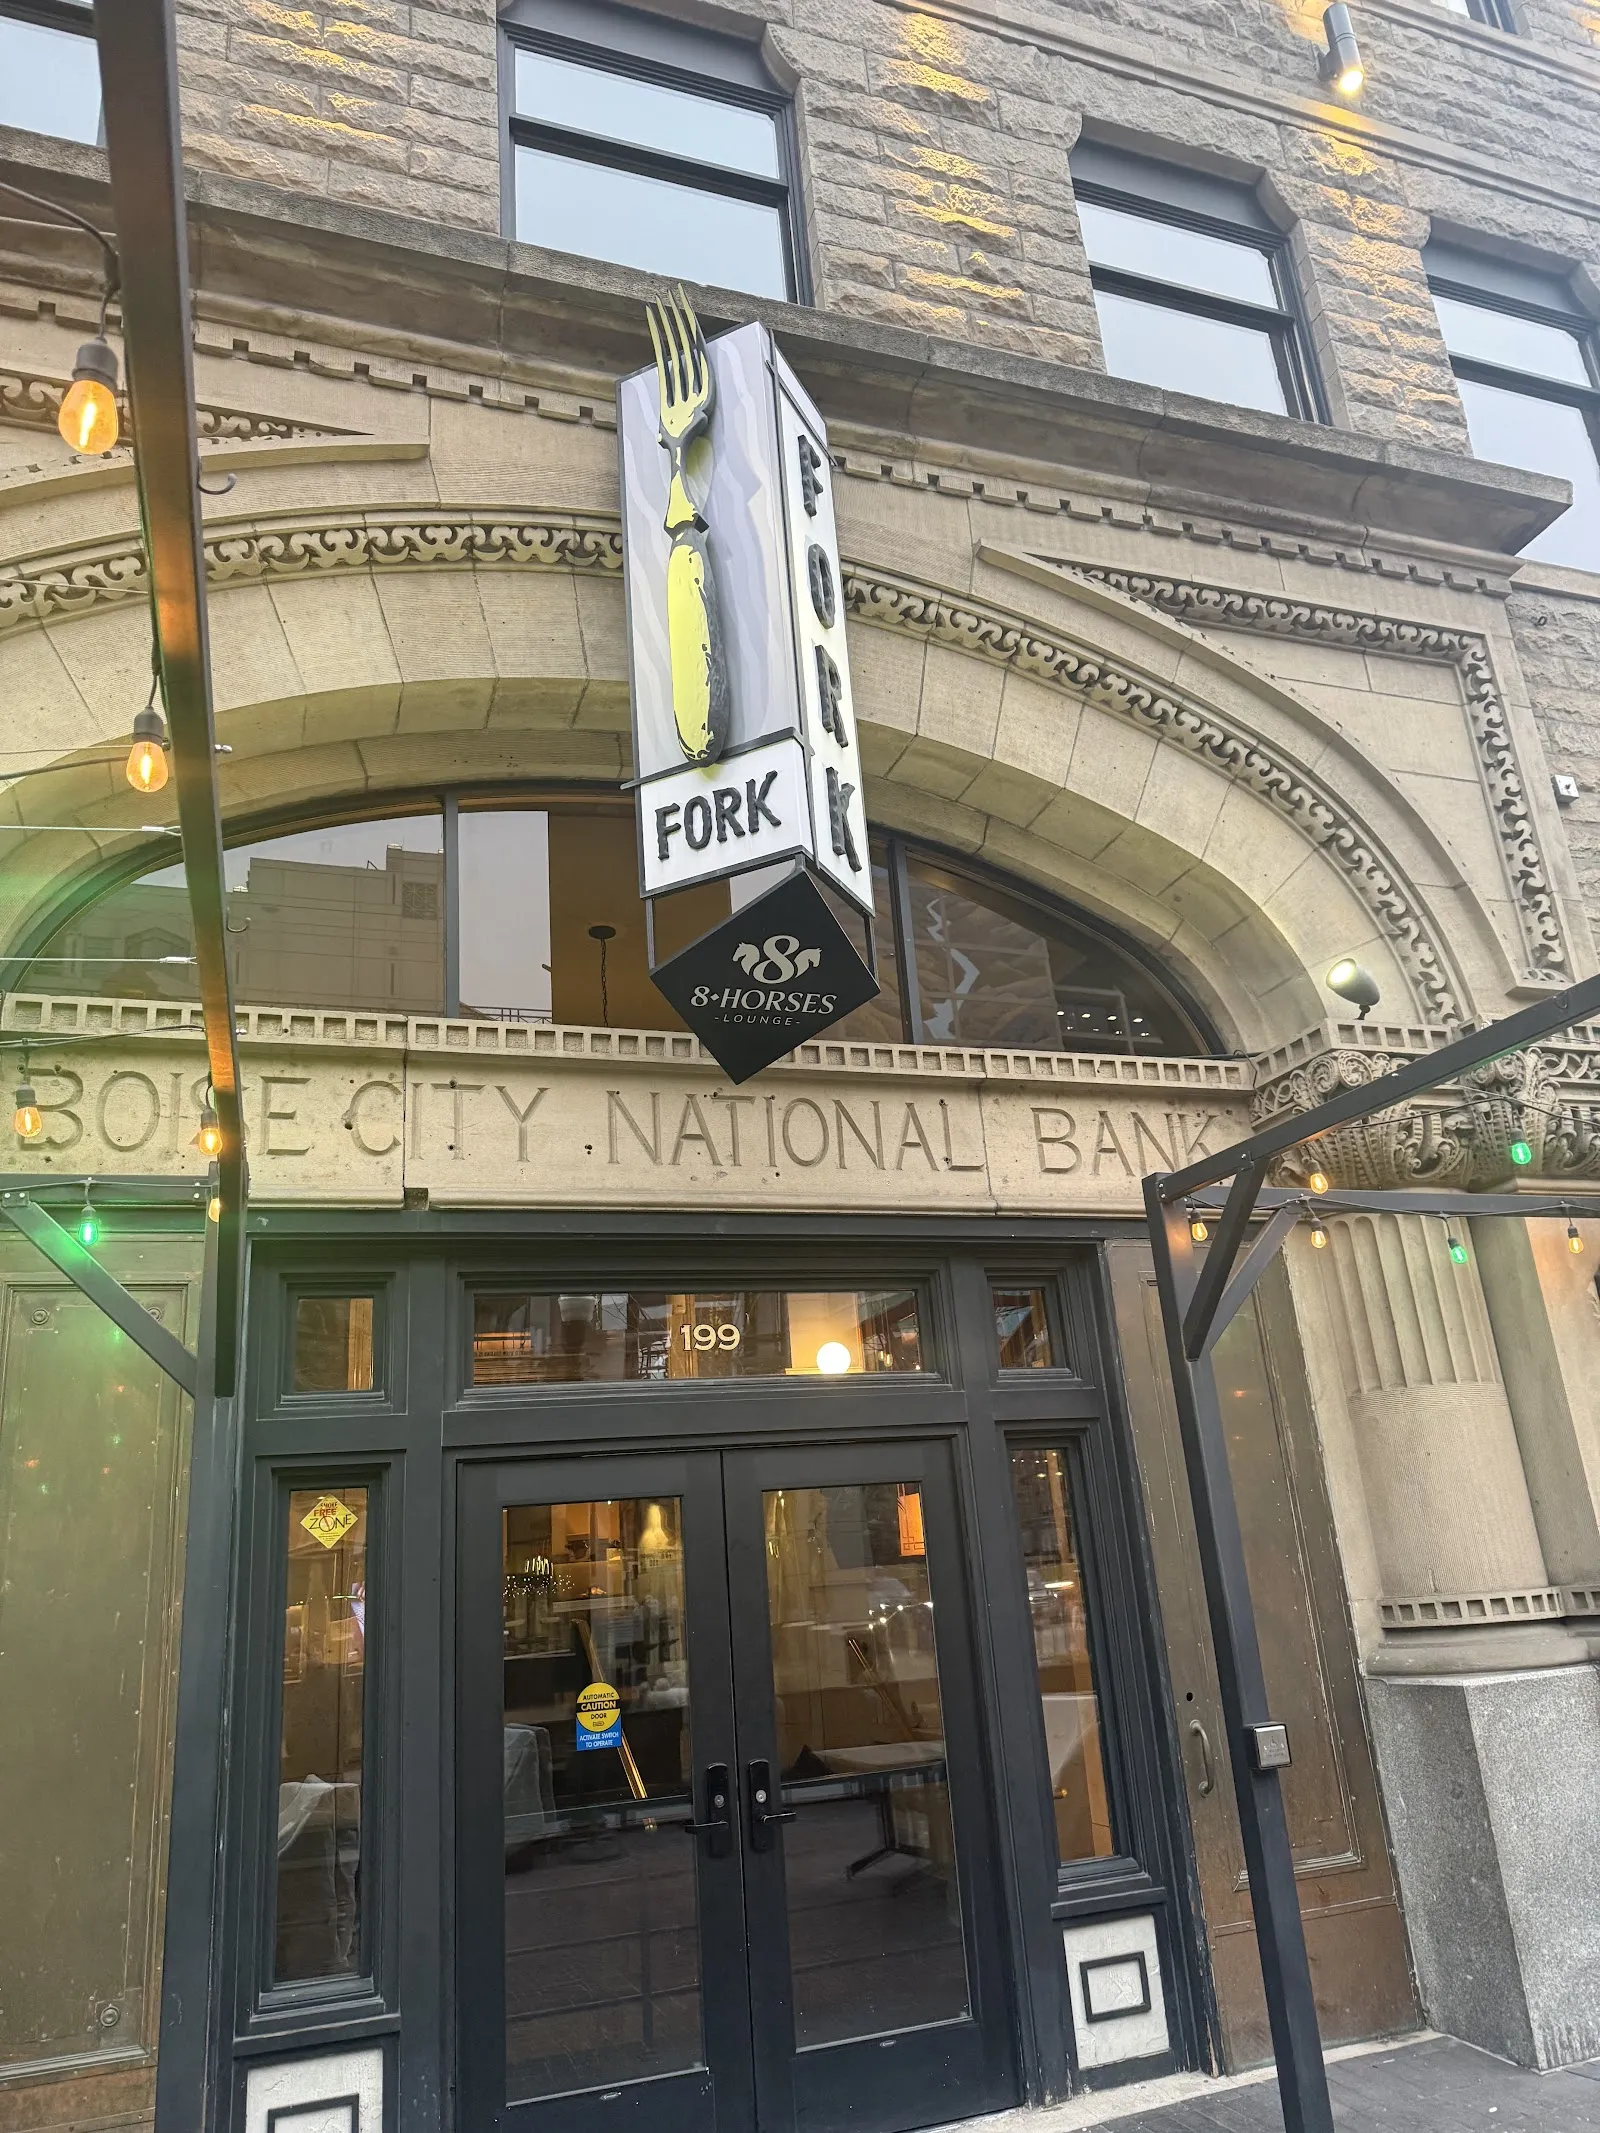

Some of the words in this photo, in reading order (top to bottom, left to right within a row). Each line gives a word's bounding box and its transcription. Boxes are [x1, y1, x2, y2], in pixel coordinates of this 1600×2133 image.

[798, 434, 863, 873] FORK
[654, 769, 782, 860] FORK
[349, 1080, 550, 1163] CITY
[605, 1089, 986, 1172] NATIONAL
[1030, 1107, 1219, 1177] BANK
[680, 1324, 740, 1351] 199
[313, 1508, 337, 1517] FREE
[309, 1513, 352, 1532] ZONE
[582, 1692, 615, 1700] AUTOMATIC
[581, 1701, 616, 1711] CAUTION
[579, 1733, 601, 1742] ACTIVATE
[601, 1731, 619, 1740] SWITCH
[593, 1740, 613, 1748] OPERATE
